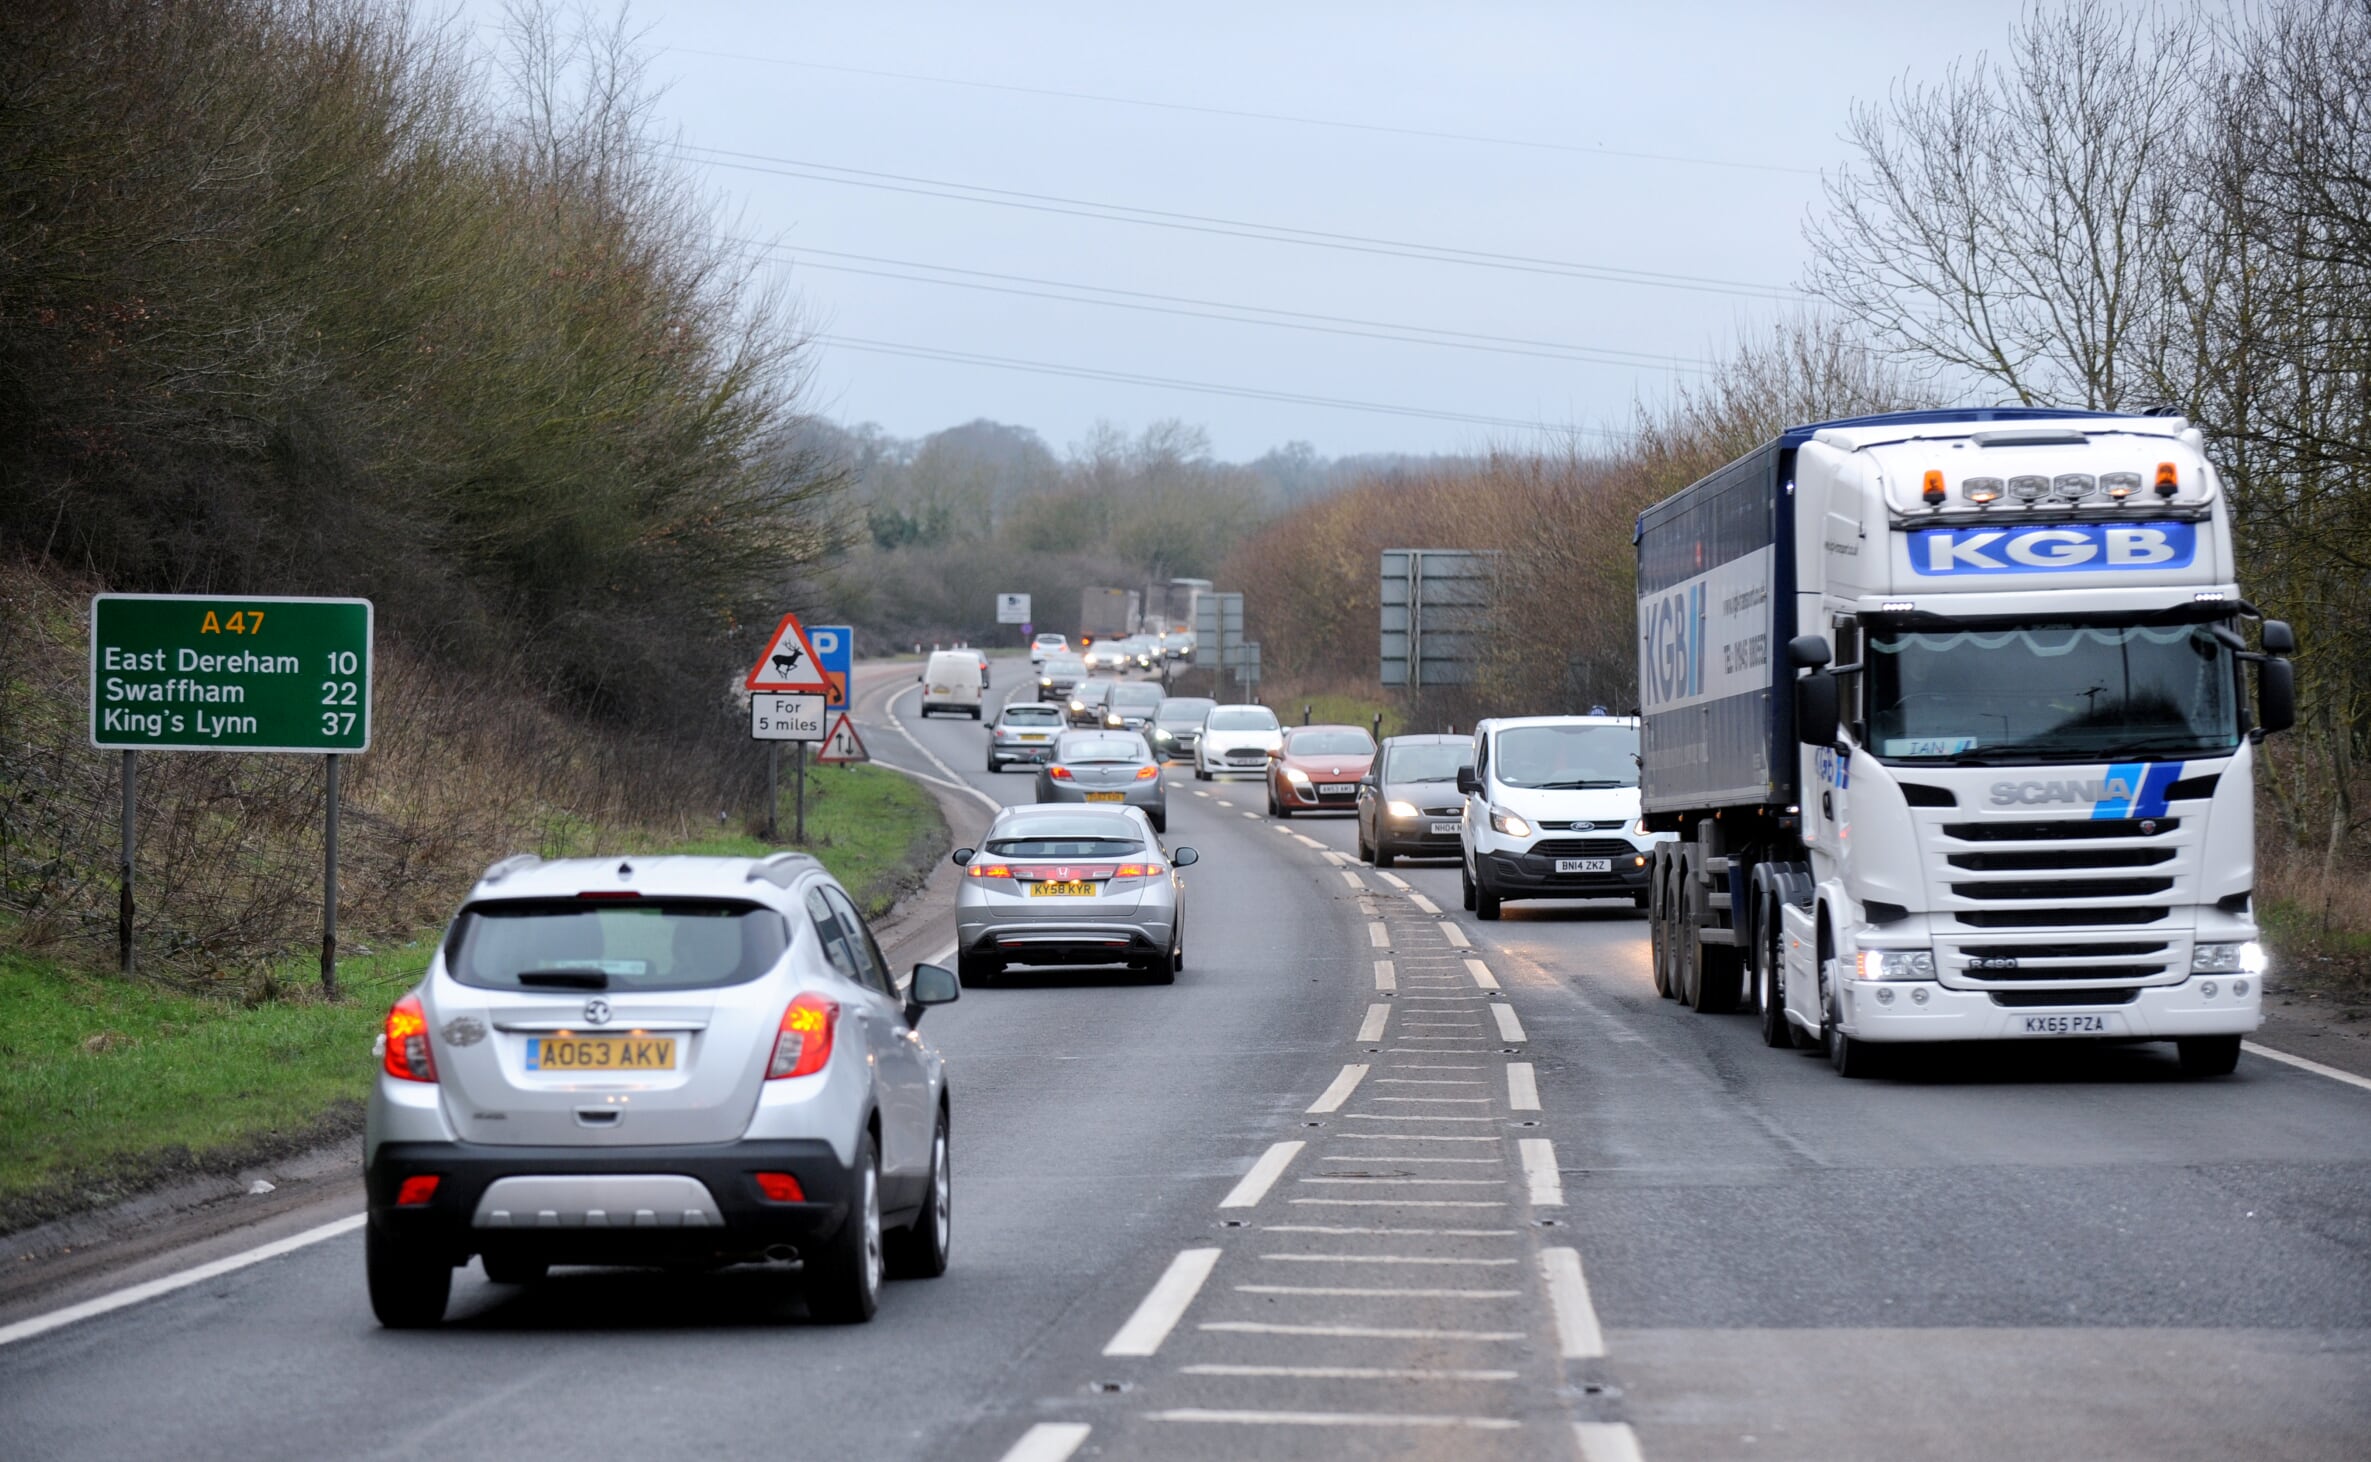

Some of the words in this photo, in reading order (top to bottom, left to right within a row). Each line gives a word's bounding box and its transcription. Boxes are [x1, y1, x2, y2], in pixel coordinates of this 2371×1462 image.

[1928, 528, 2177, 571] KGB
[200, 611, 265, 635] A47
[812, 632, 839, 654] P
[1645, 593, 1688, 706] KGB
[104, 647, 167, 672] East
[178, 649, 299, 674] Dereham
[327, 651, 358, 675] 10
[105, 677, 245, 703] Swaffham
[321, 681, 358, 706] 22
[776, 700, 802, 713] For
[104, 708, 185, 737] King's
[196, 710, 257, 738] Lynn
[321, 712, 357, 736] 37
[759, 717, 769, 730] 5
[776, 718, 818, 731] miles
[1909, 741, 1946, 755] IAN
[1989, 778, 2133, 805] SCANIA
[1562, 861, 1583, 870] BN14
[1586, 861, 1605, 870] ZKZ
[1034, 884, 1065, 895] KY58
[1069, 884, 1092, 895] KYR
[2025, 1017, 2068, 1032] KX65
[2073, 1016, 2104, 1031] PZA
[543, 1042, 611, 1066] AO63
[620, 1042, 670, 1066] AKV
